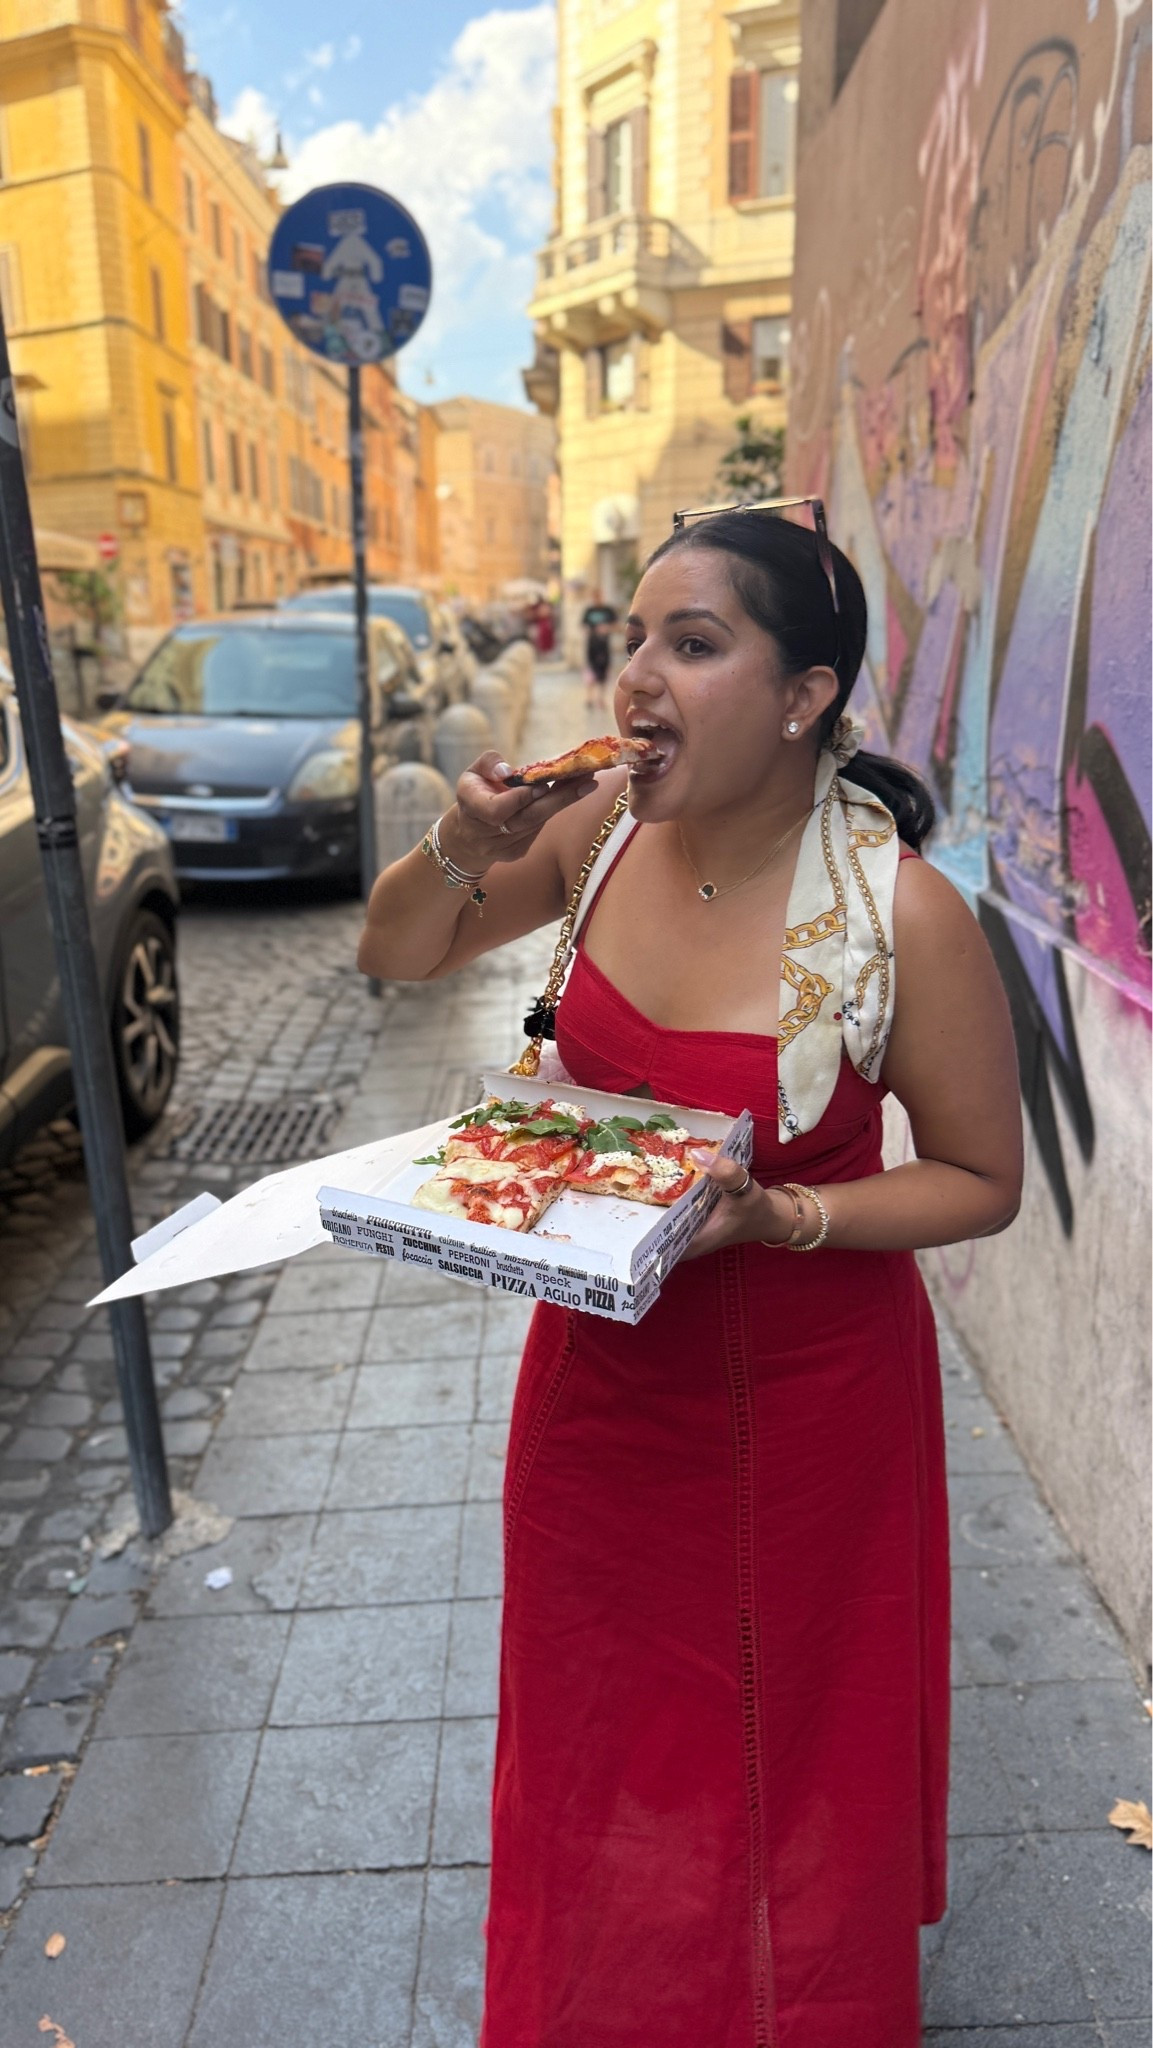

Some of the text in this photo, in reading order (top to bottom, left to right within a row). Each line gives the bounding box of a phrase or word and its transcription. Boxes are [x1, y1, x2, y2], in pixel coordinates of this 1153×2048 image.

[322, 1219, 572, 1289] ORIGANO FUNGHI ZUCCHINE PEPERONI bruschetta speck
[375, 1243, 395, 1257] PESTO
[402, 1248, 433, 1265] focaccia
[438, 1259, 483, 1280] SALSICCIA
[491, 1272, 537, 1298] PIZZA
[543, 1287, 581, 1306] AGLIO
[585, 1287, 616, 1312] PIZZA
[504, 1253, 550, 1272] mozzarella
[594, 1274, 619, 1292] OLIO
